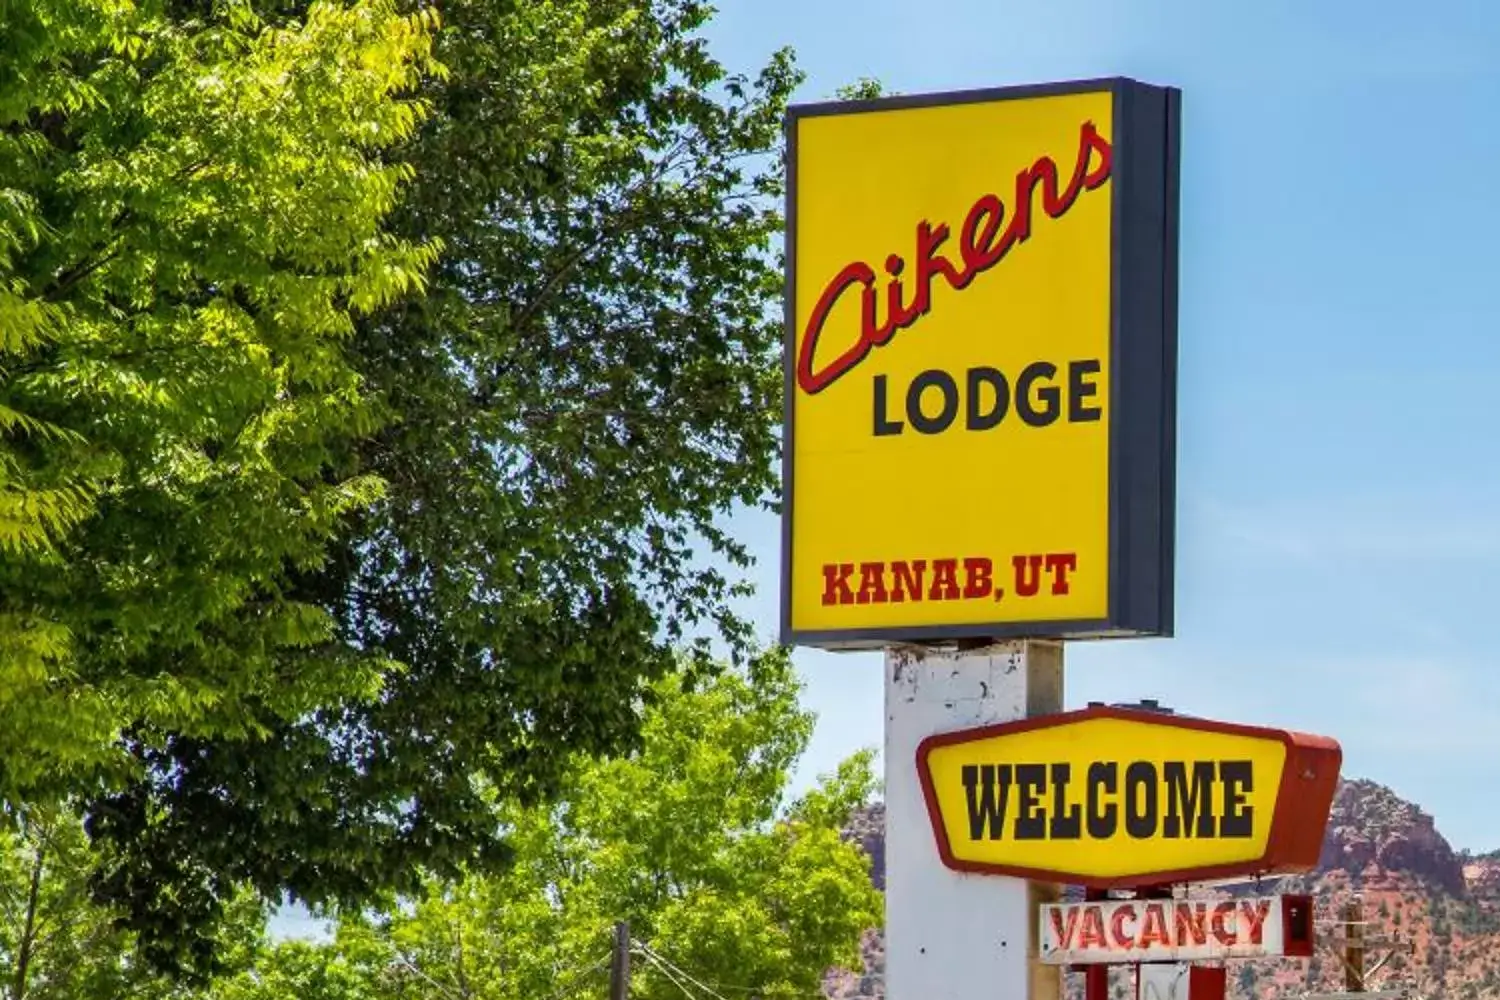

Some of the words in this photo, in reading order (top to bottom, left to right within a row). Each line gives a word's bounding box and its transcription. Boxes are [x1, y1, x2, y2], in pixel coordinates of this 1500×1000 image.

[798, 119, 1113, 394] Aikens
[872, 359, 1102, 436] LODGE
[1013, 553, 1077, 595] UT
[961, 759, 1254, 841] WELCOME
[1048, 900, 1272, 951] VACANCY
